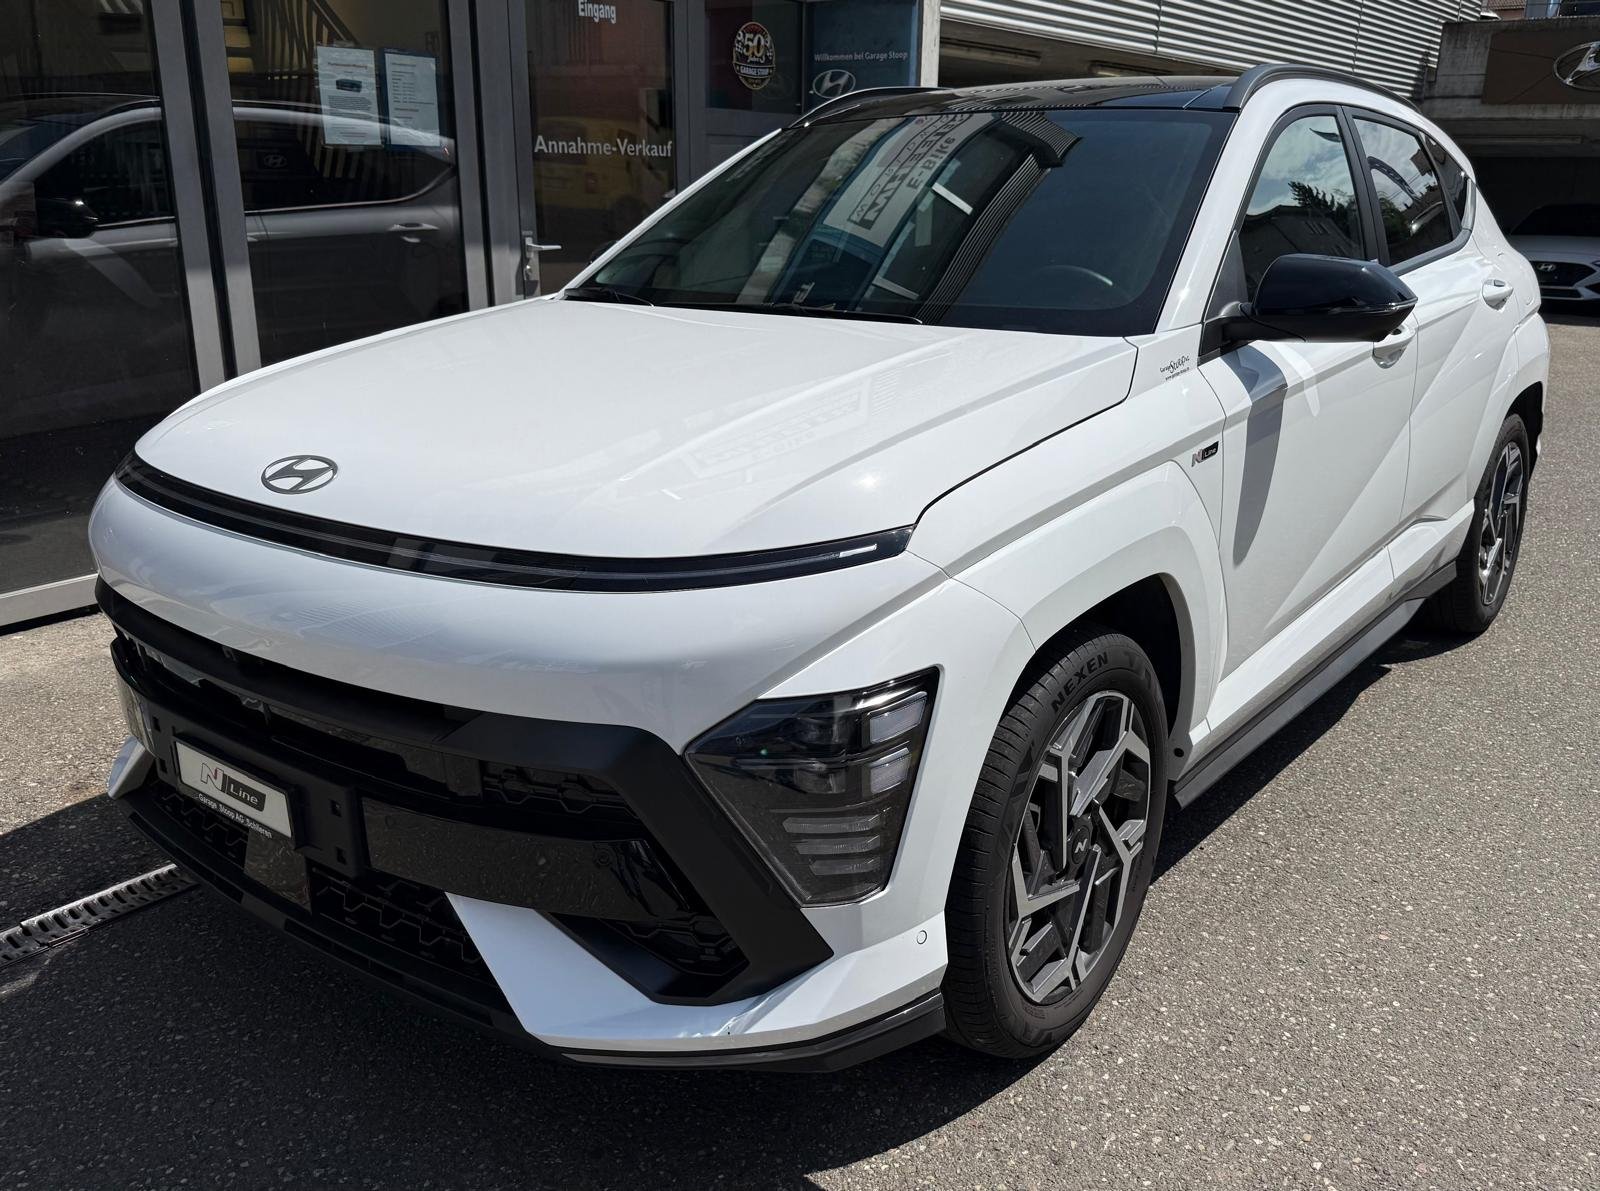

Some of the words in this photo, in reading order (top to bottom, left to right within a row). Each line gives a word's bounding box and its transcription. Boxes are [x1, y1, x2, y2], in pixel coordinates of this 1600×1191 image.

[578, 0, 617, 24] Eingang
[744, 33, 765, 57] 50
[814, 52, 853, 61] Willkommen
[854, 52, 864, 60] bei
[865, 51, 887, 61] Garage
[888, 51, 908, 60] Stoop
[534, 135, 673, 157] Annahme-Verkauf
[1051, 651, 1108, 713] NEXEN
[200, 762, 225, 792] N
[229, 783, 259, 806] Line
